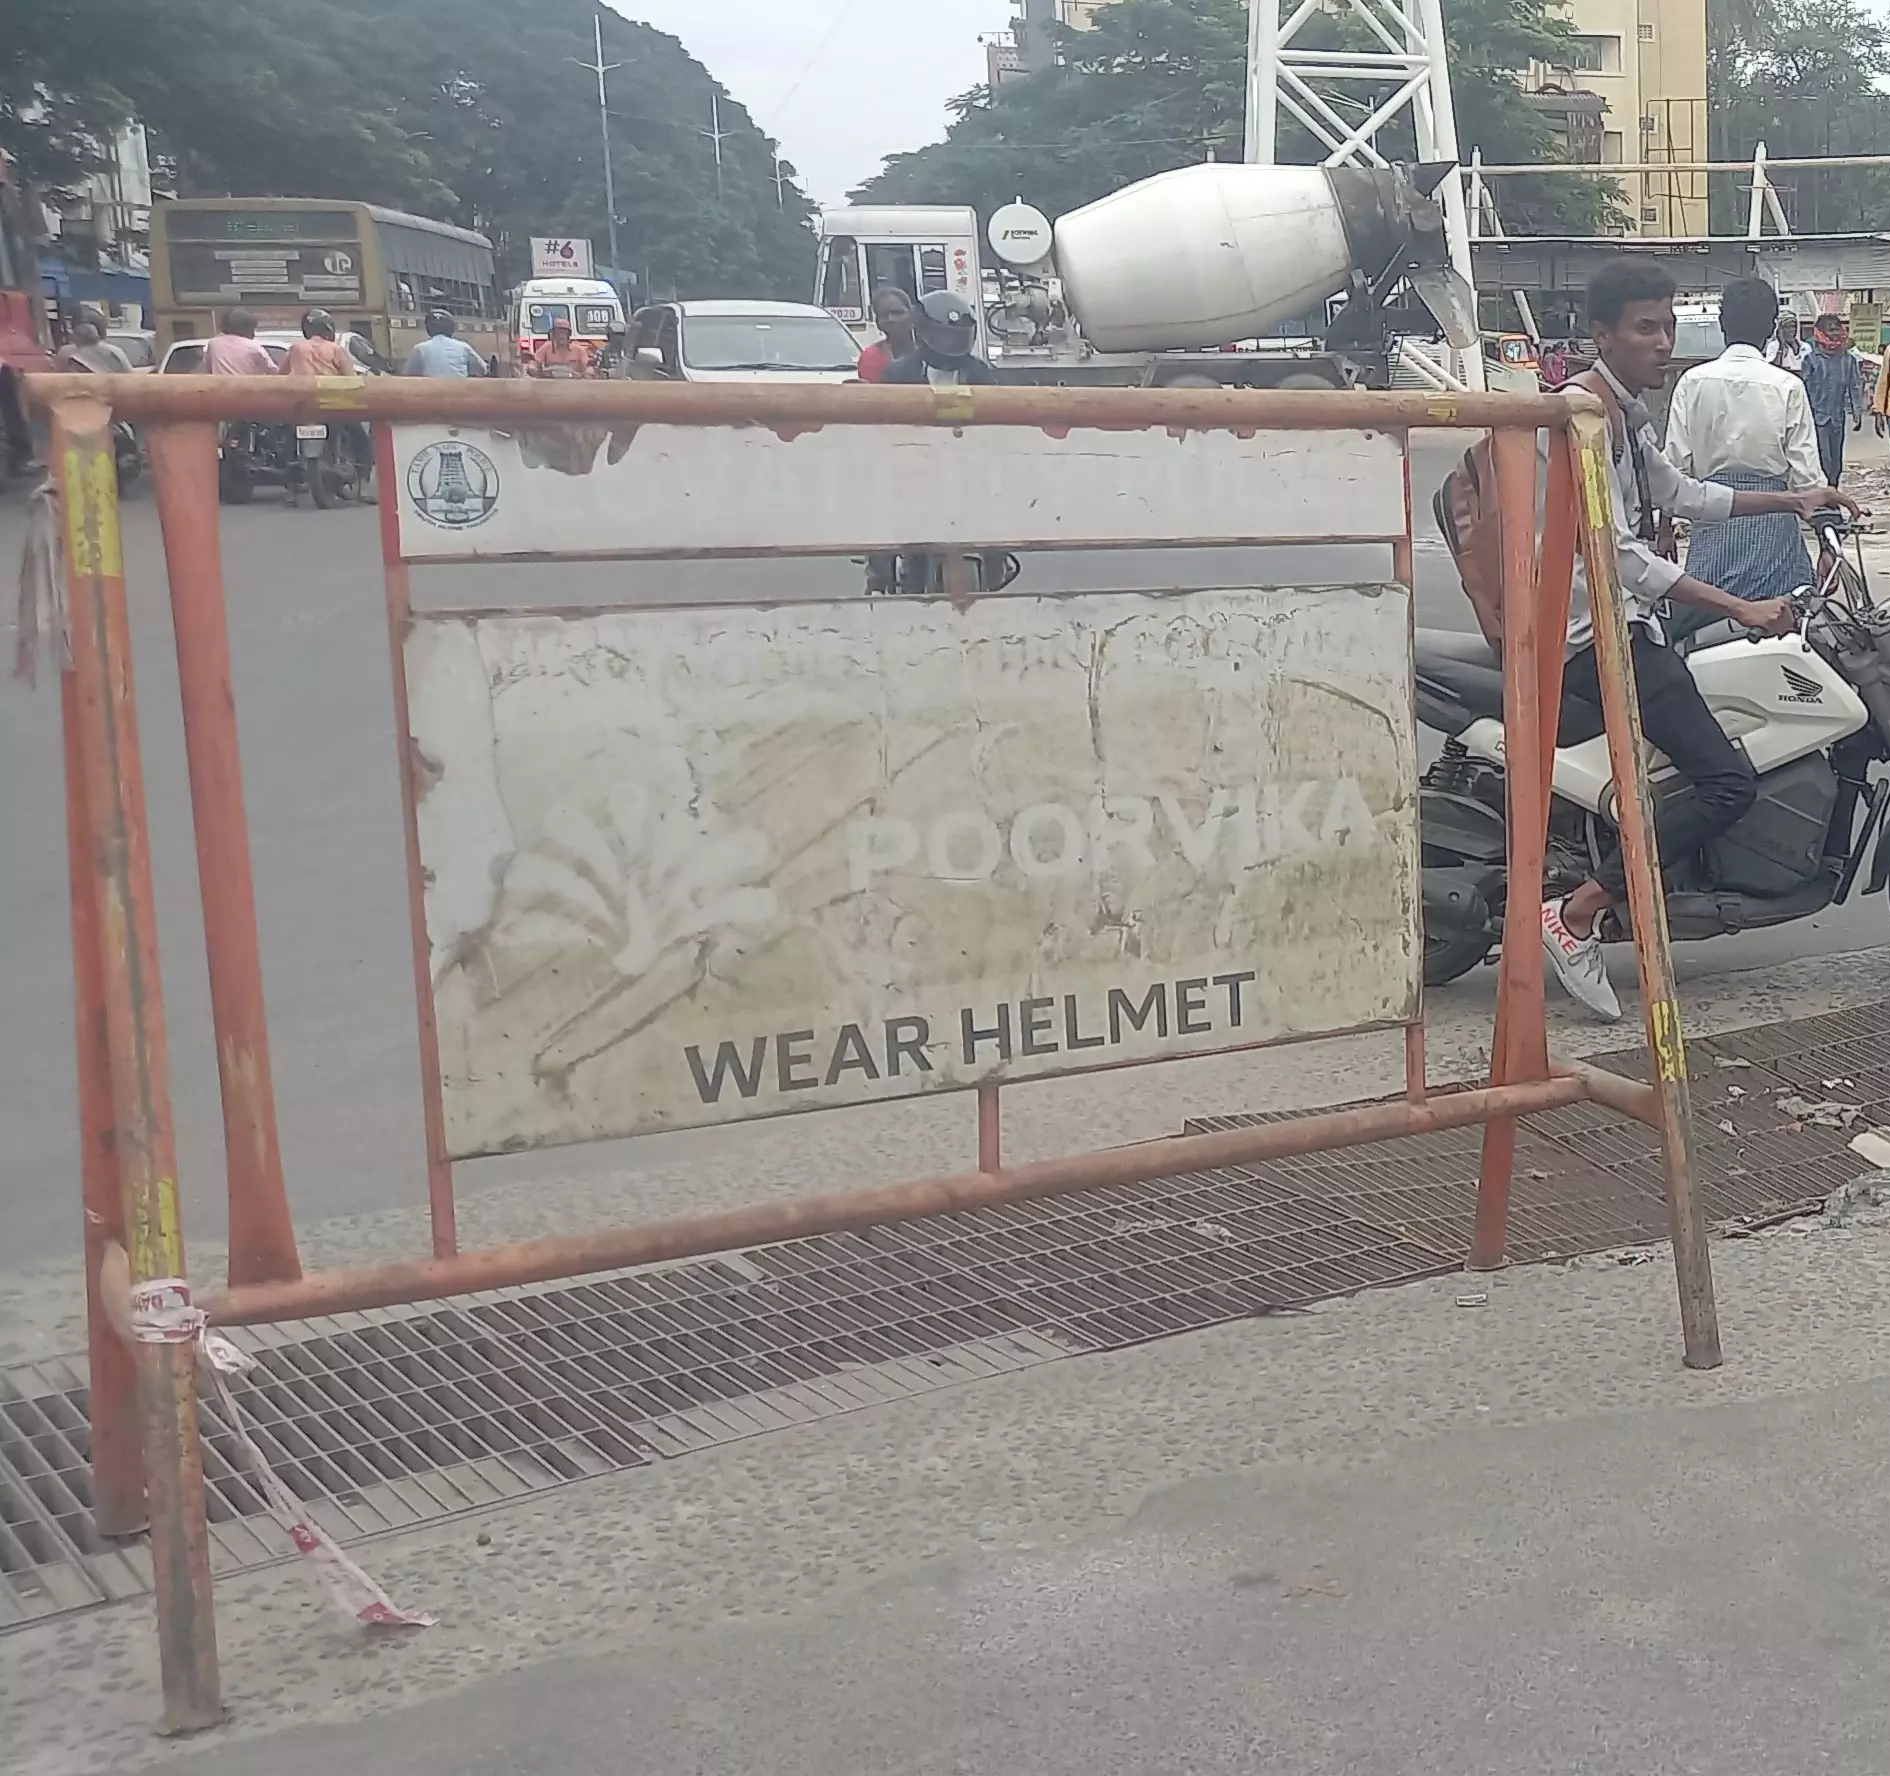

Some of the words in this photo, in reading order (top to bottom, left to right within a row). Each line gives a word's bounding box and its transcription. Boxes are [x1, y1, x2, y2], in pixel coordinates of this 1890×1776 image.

[541, 260, 579, 268] HOTELS
[545, 239, 575, 260] #6
[1778, 694, 1823, 704] HONDA
[846, 776, 1377, 893] POORVIKA
[1540, 904, 1578, 955] NIKE
[684, 1014, 933, 1104] WEAR
[961, 970, 1256, 1066] HELMET
